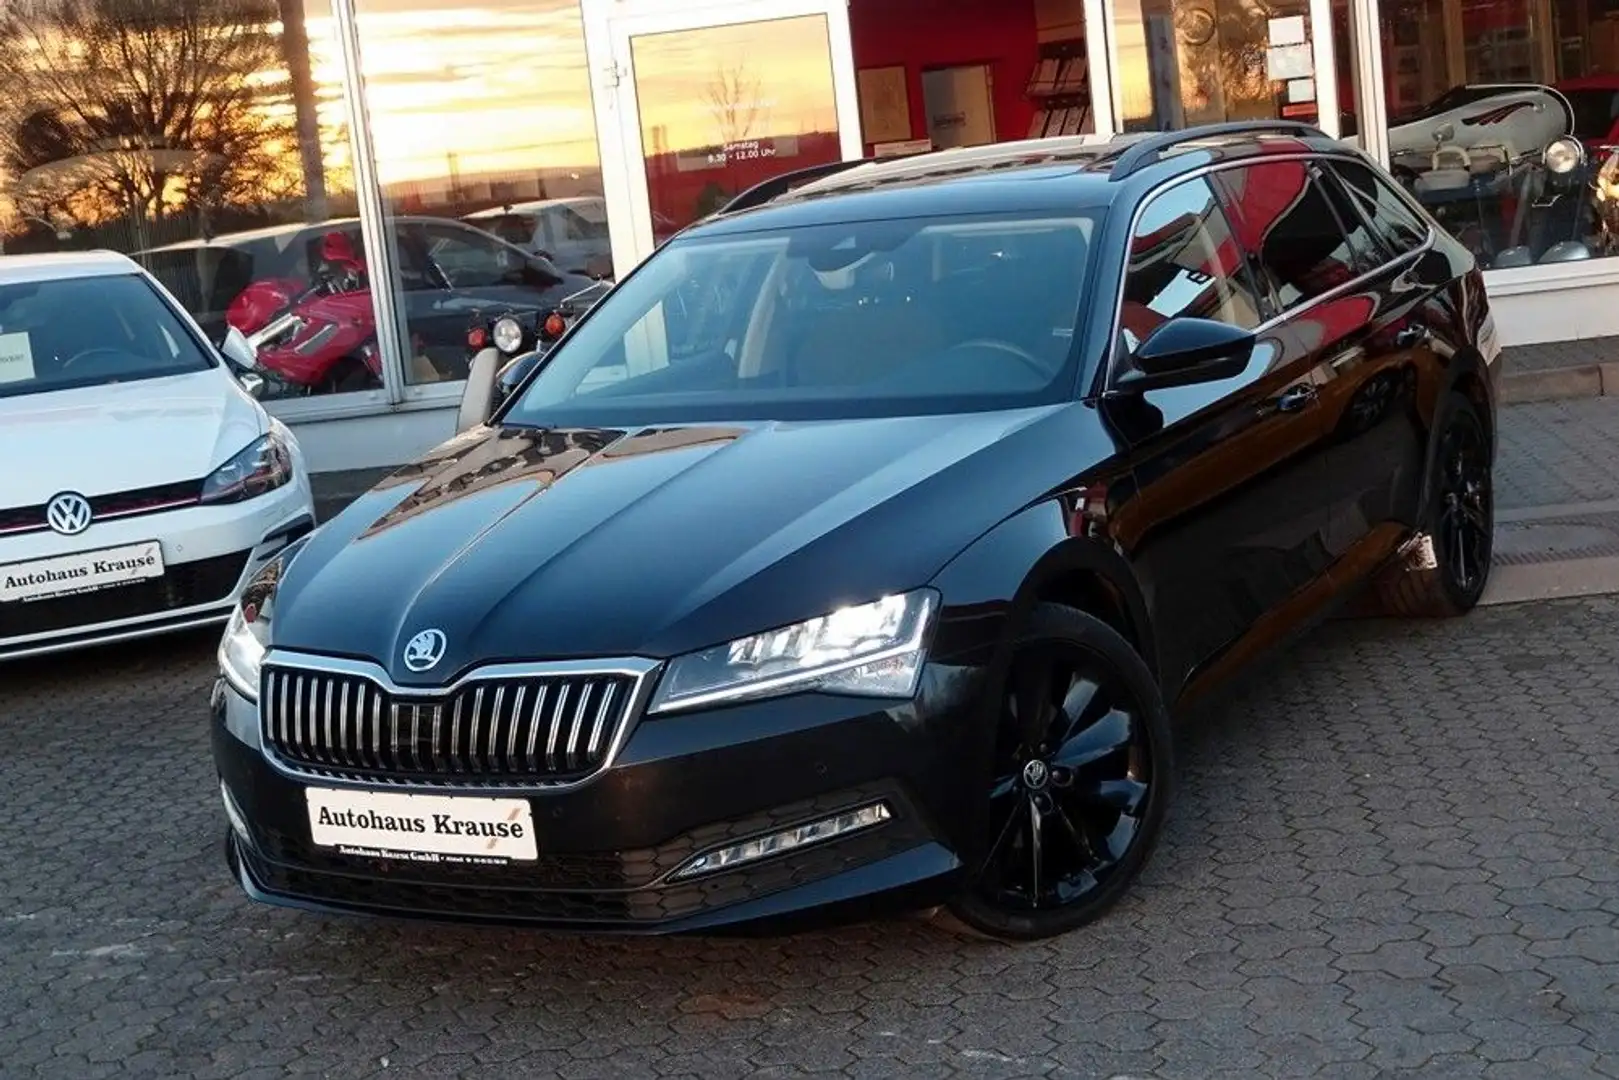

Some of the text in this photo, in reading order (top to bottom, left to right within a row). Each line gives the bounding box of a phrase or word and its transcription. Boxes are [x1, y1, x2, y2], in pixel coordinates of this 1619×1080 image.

[5, 555, 155, 588] Autohaus Krause
[318, 806, 524, 838] Autohaus Krause
